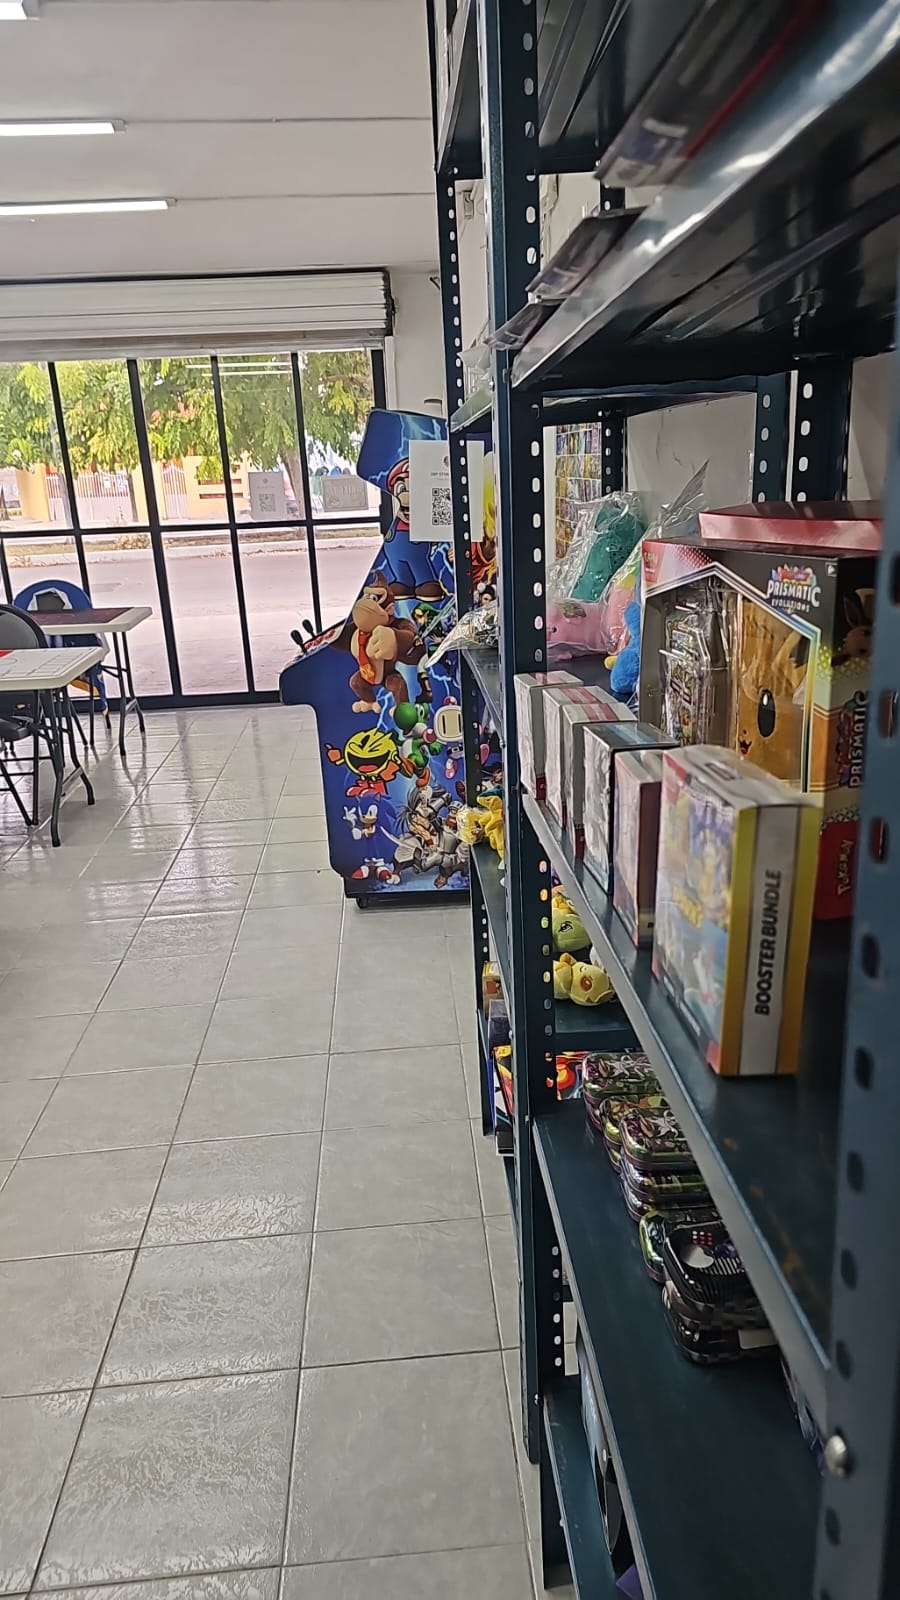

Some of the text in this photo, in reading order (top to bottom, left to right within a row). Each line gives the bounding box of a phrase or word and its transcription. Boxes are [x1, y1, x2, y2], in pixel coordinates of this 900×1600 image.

[766, 579, 821, 608] PRISMATIC
[849, 691, 870, 787] PRISMATIC
[754, 869, 782, 1016] BOOSTER BUNDLE
